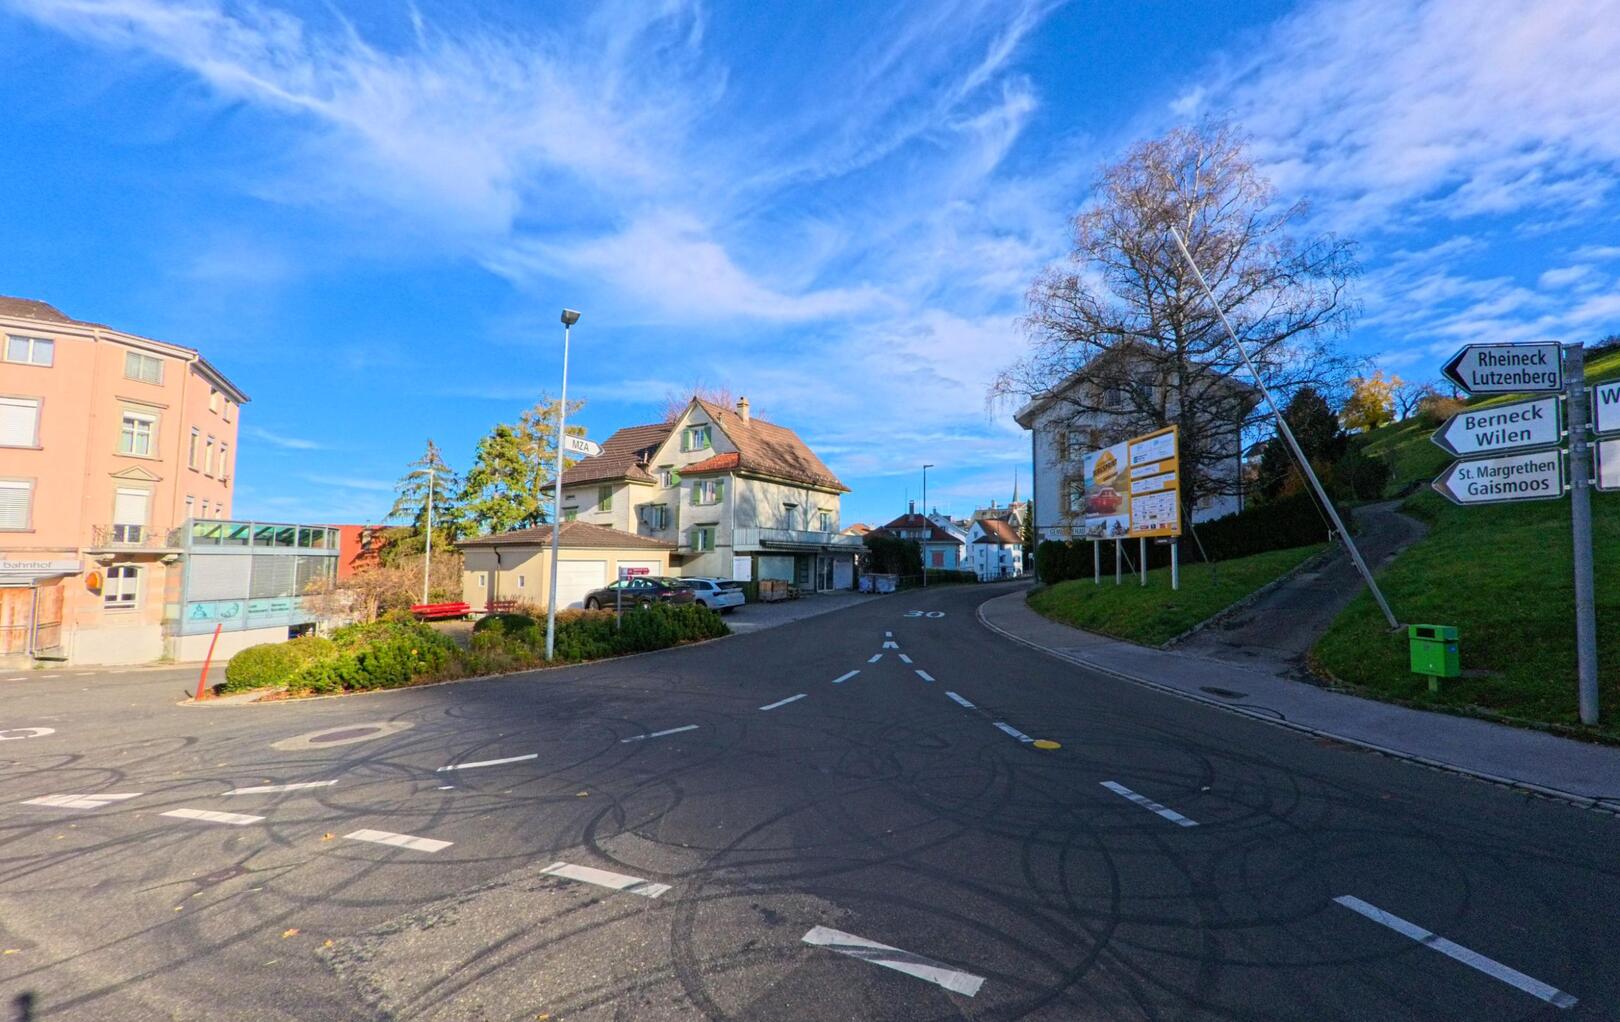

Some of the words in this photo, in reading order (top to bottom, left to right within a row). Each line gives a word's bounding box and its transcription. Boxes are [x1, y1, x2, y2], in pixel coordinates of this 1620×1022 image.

[1478, 350, 1547, 367] Rheineck
[1472, 368, 1557, 388] Lutzenberg
[1465, 404, 1543, 430] Berneck
[572, 439, 590, 452] MZA
[1475, 429, 1532, 447] Wilen
[1458, 467, 1474, 481] St.
[1477, 460, 1556, 480] Margrethen
[1467, 477, 1550, 496] Gaismoos
[3, 561, 52, 569] bahnhof
[903, 610, 946, 618] 30
